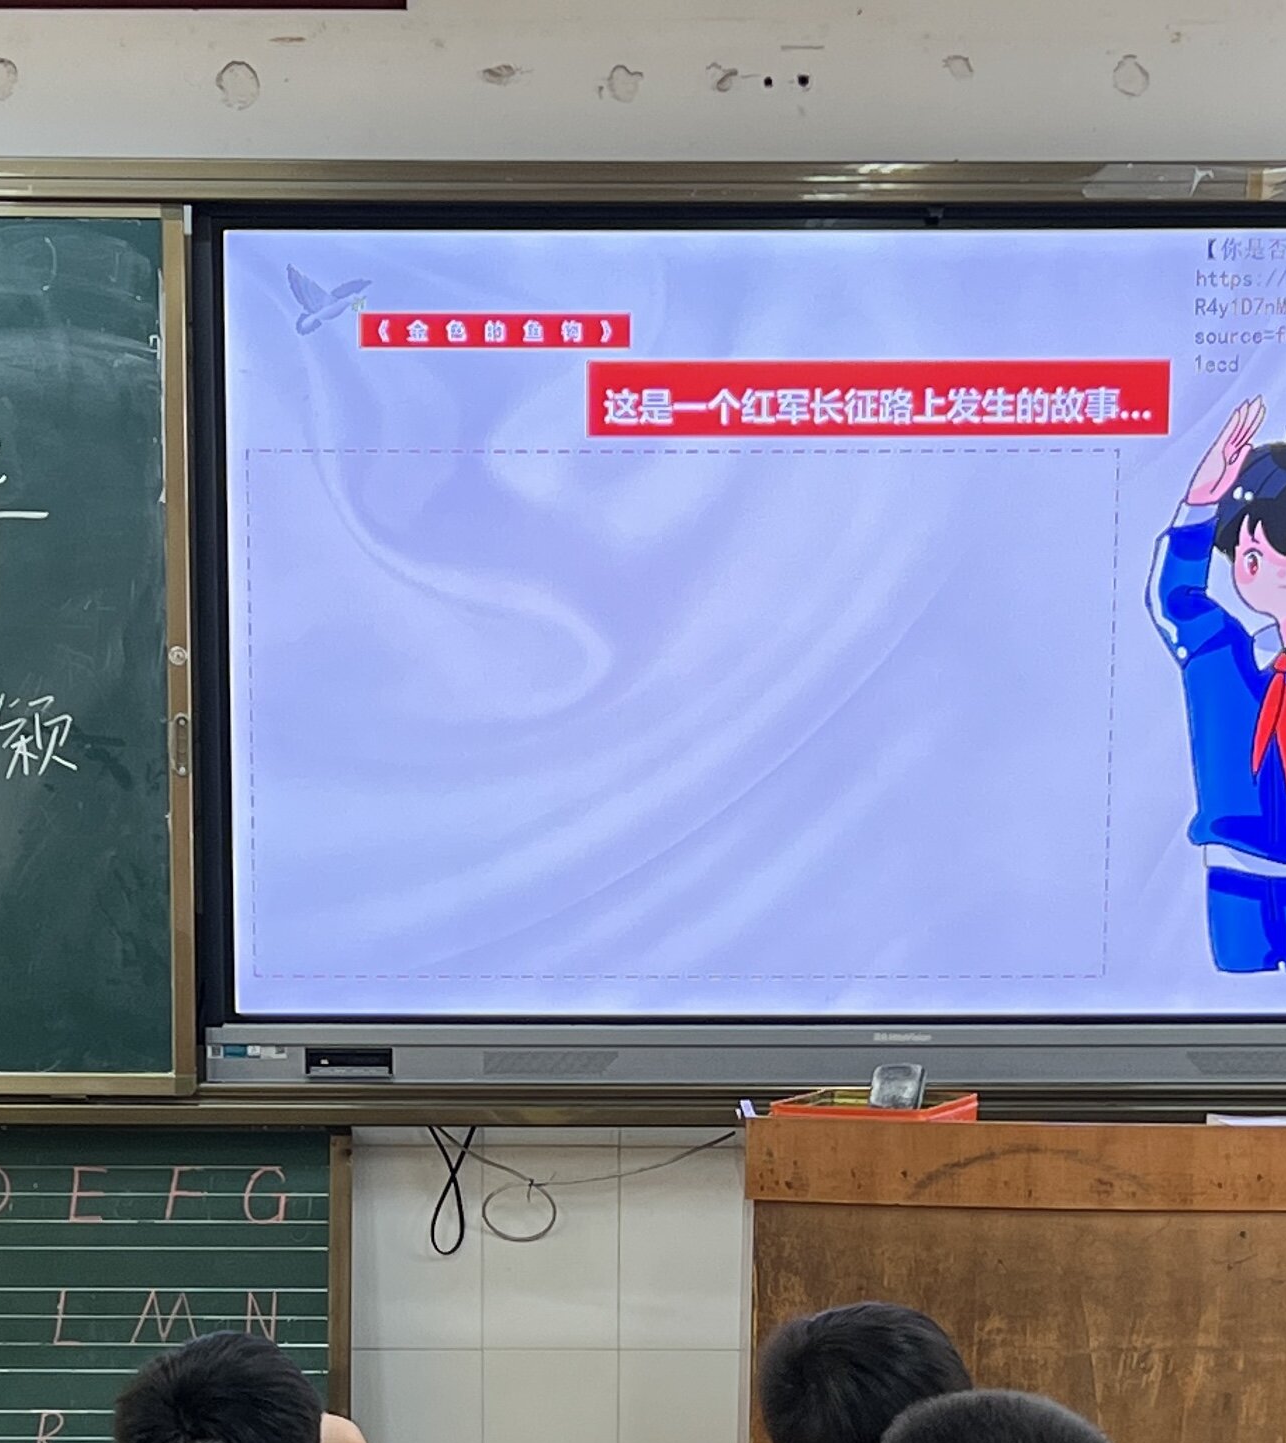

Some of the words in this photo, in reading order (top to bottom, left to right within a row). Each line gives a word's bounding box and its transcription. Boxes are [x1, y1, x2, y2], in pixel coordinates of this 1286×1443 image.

[378, 319, 612, 343] 《金色的鱼钩》
[604, 387, 1153, 426] 这是一个红军长征路上发生的故事...
[69, 1167, 108, 1223] E
[165, 1167, 205, 1221] F
[244, 1166, 288, 1224] G
[53, 1290, 81, 1345] L
[131, 1291, 197, 1343] M
[247, 1291, 278, 1341] N
